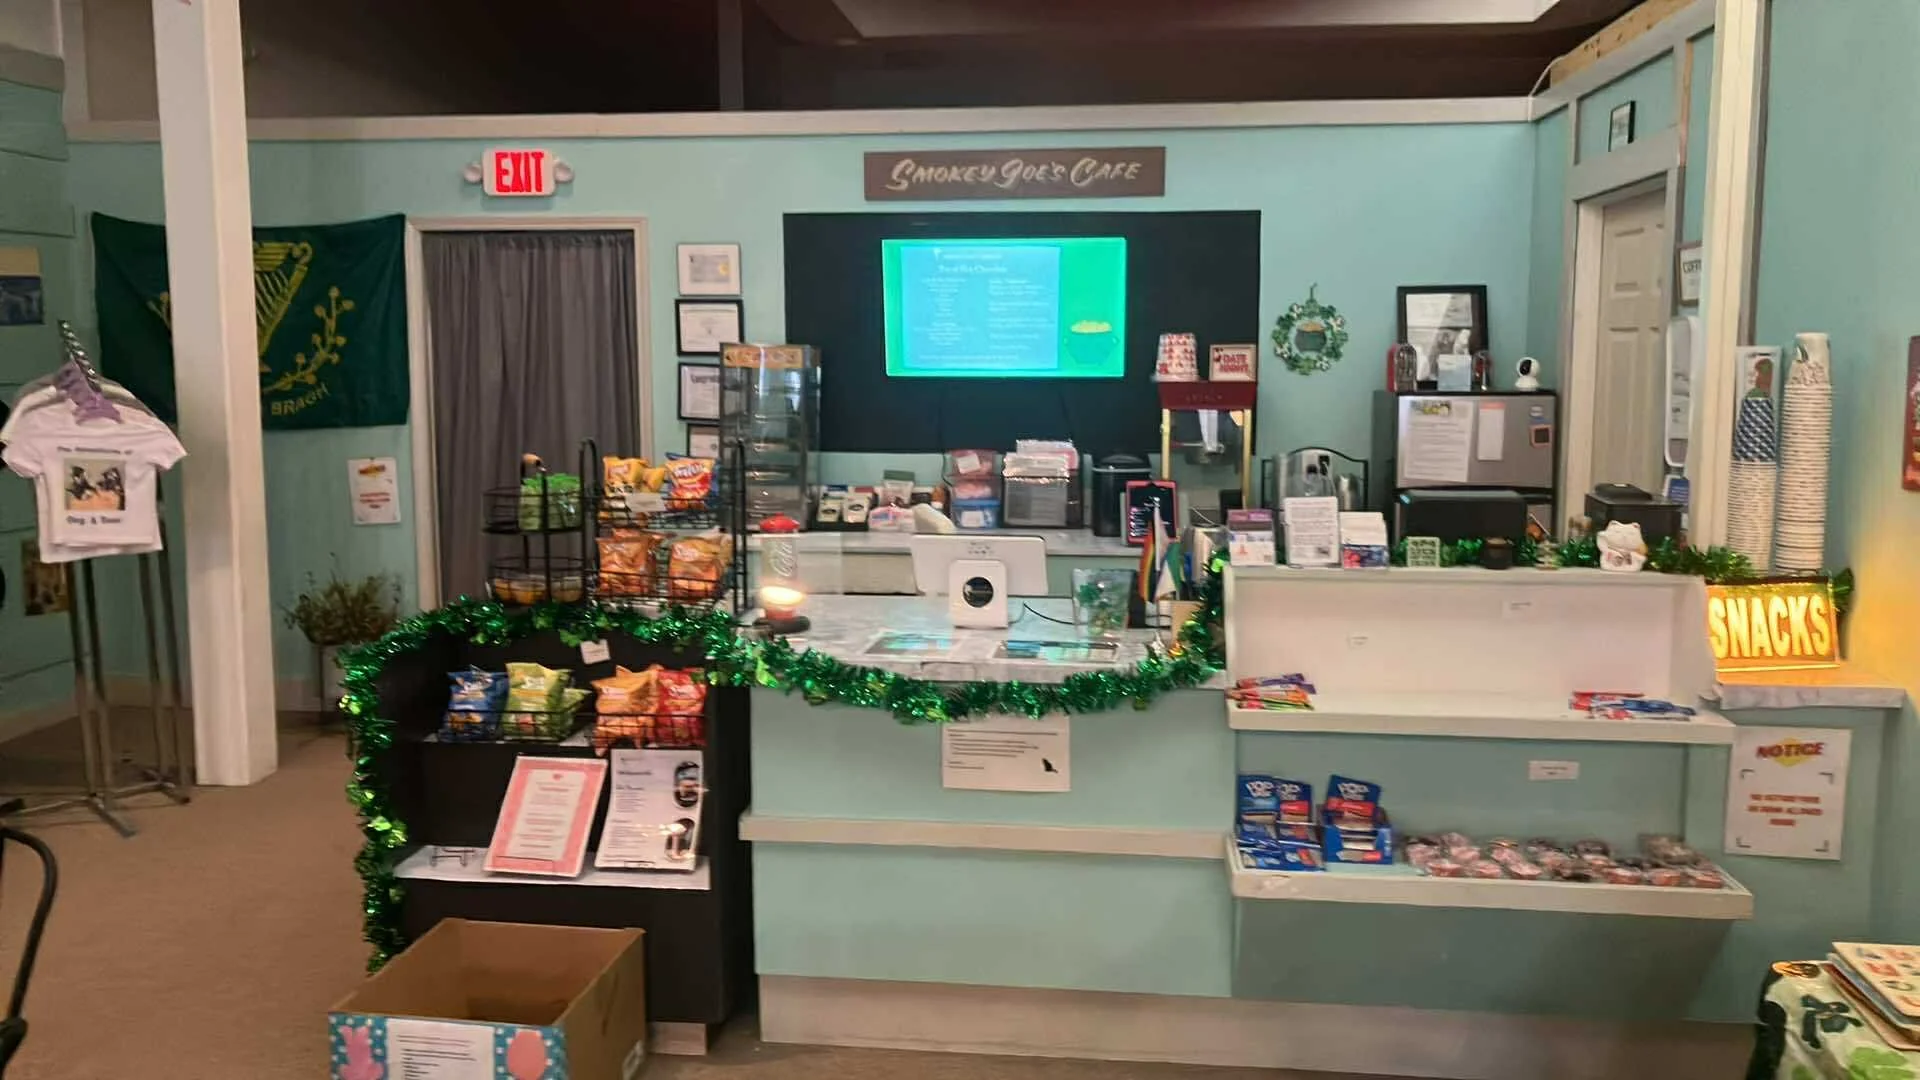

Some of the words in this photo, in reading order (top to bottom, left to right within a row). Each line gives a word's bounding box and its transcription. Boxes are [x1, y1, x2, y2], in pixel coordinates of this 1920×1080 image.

[495, 152, 544, 192] EXIT
[885, 158, 996, 190] SMOKEY
[993, 158, 1066, 189] JOE'S
[1070, 157, 1142, 188] CAFE
[271, 382, 330, 416] BRAGH
[1708, 594, 1831, 659] SNACKS
[1756, 742, 1825, 758] NOTICE
